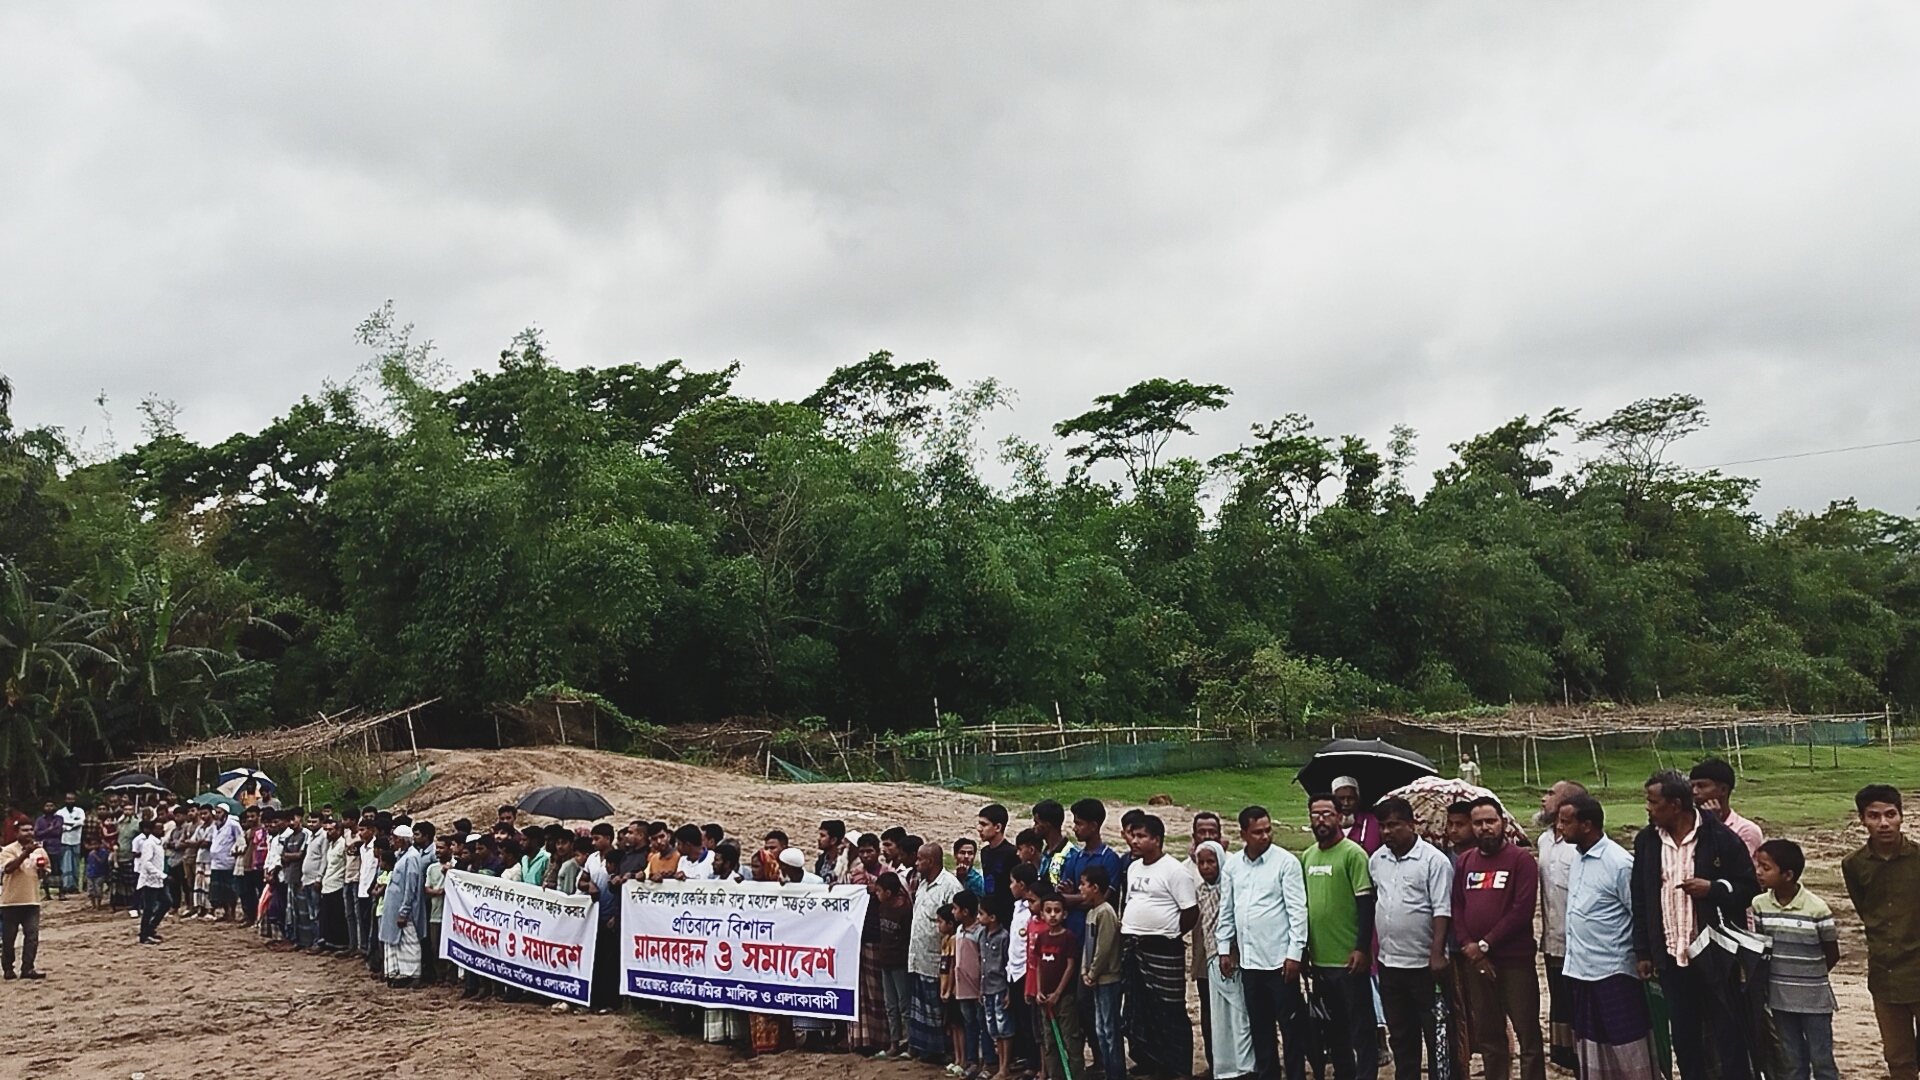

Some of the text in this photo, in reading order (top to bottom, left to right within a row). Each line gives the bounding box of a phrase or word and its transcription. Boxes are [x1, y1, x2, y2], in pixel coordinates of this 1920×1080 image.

[710, 888, 727, 906] জমি
[729, 892, 745, 911] বালু
[748, 893, 779, 909] মহালে
[822, 897, 851, 912] করার
[473, 902, 541, 936] প্রতিবাদে বিশাল
[672, 910, 775, 940] প্রতিবাদে বিশাল
[505, 933, 516, 957] ও
[522, 936, 583, 971] সমাবেশ
[634, 934, 836, 979] মানববন্ধন ও সমাবেশ
[535, 976, 541, 986] ও
[698, 981, 723, 998] জমির
[725, 983, 758, 1002] মালিক
[761, 991, 771, 1003] ও
[774, 990, 839, 1010] এলাকাবাসী
